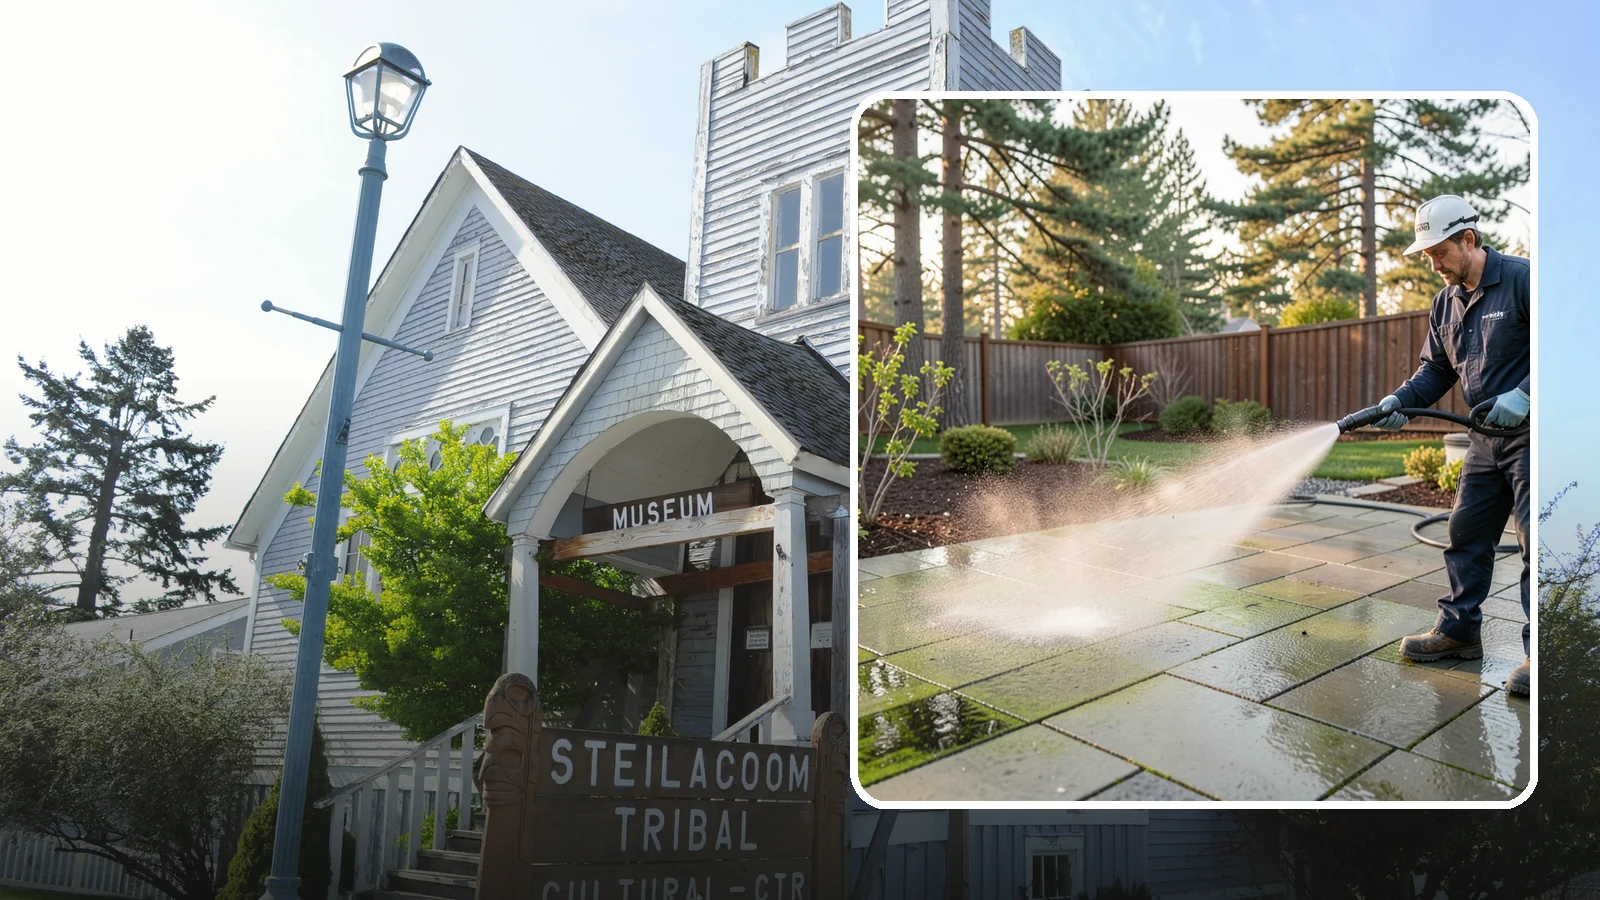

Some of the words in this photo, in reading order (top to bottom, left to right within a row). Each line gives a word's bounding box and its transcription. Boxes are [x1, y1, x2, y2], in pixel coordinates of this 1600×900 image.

[613, 492, 713, 530] MUSEUM
[551, 738, 809, 792] STEILACOOM
[615, 806, 757, 850] TRIBAL
